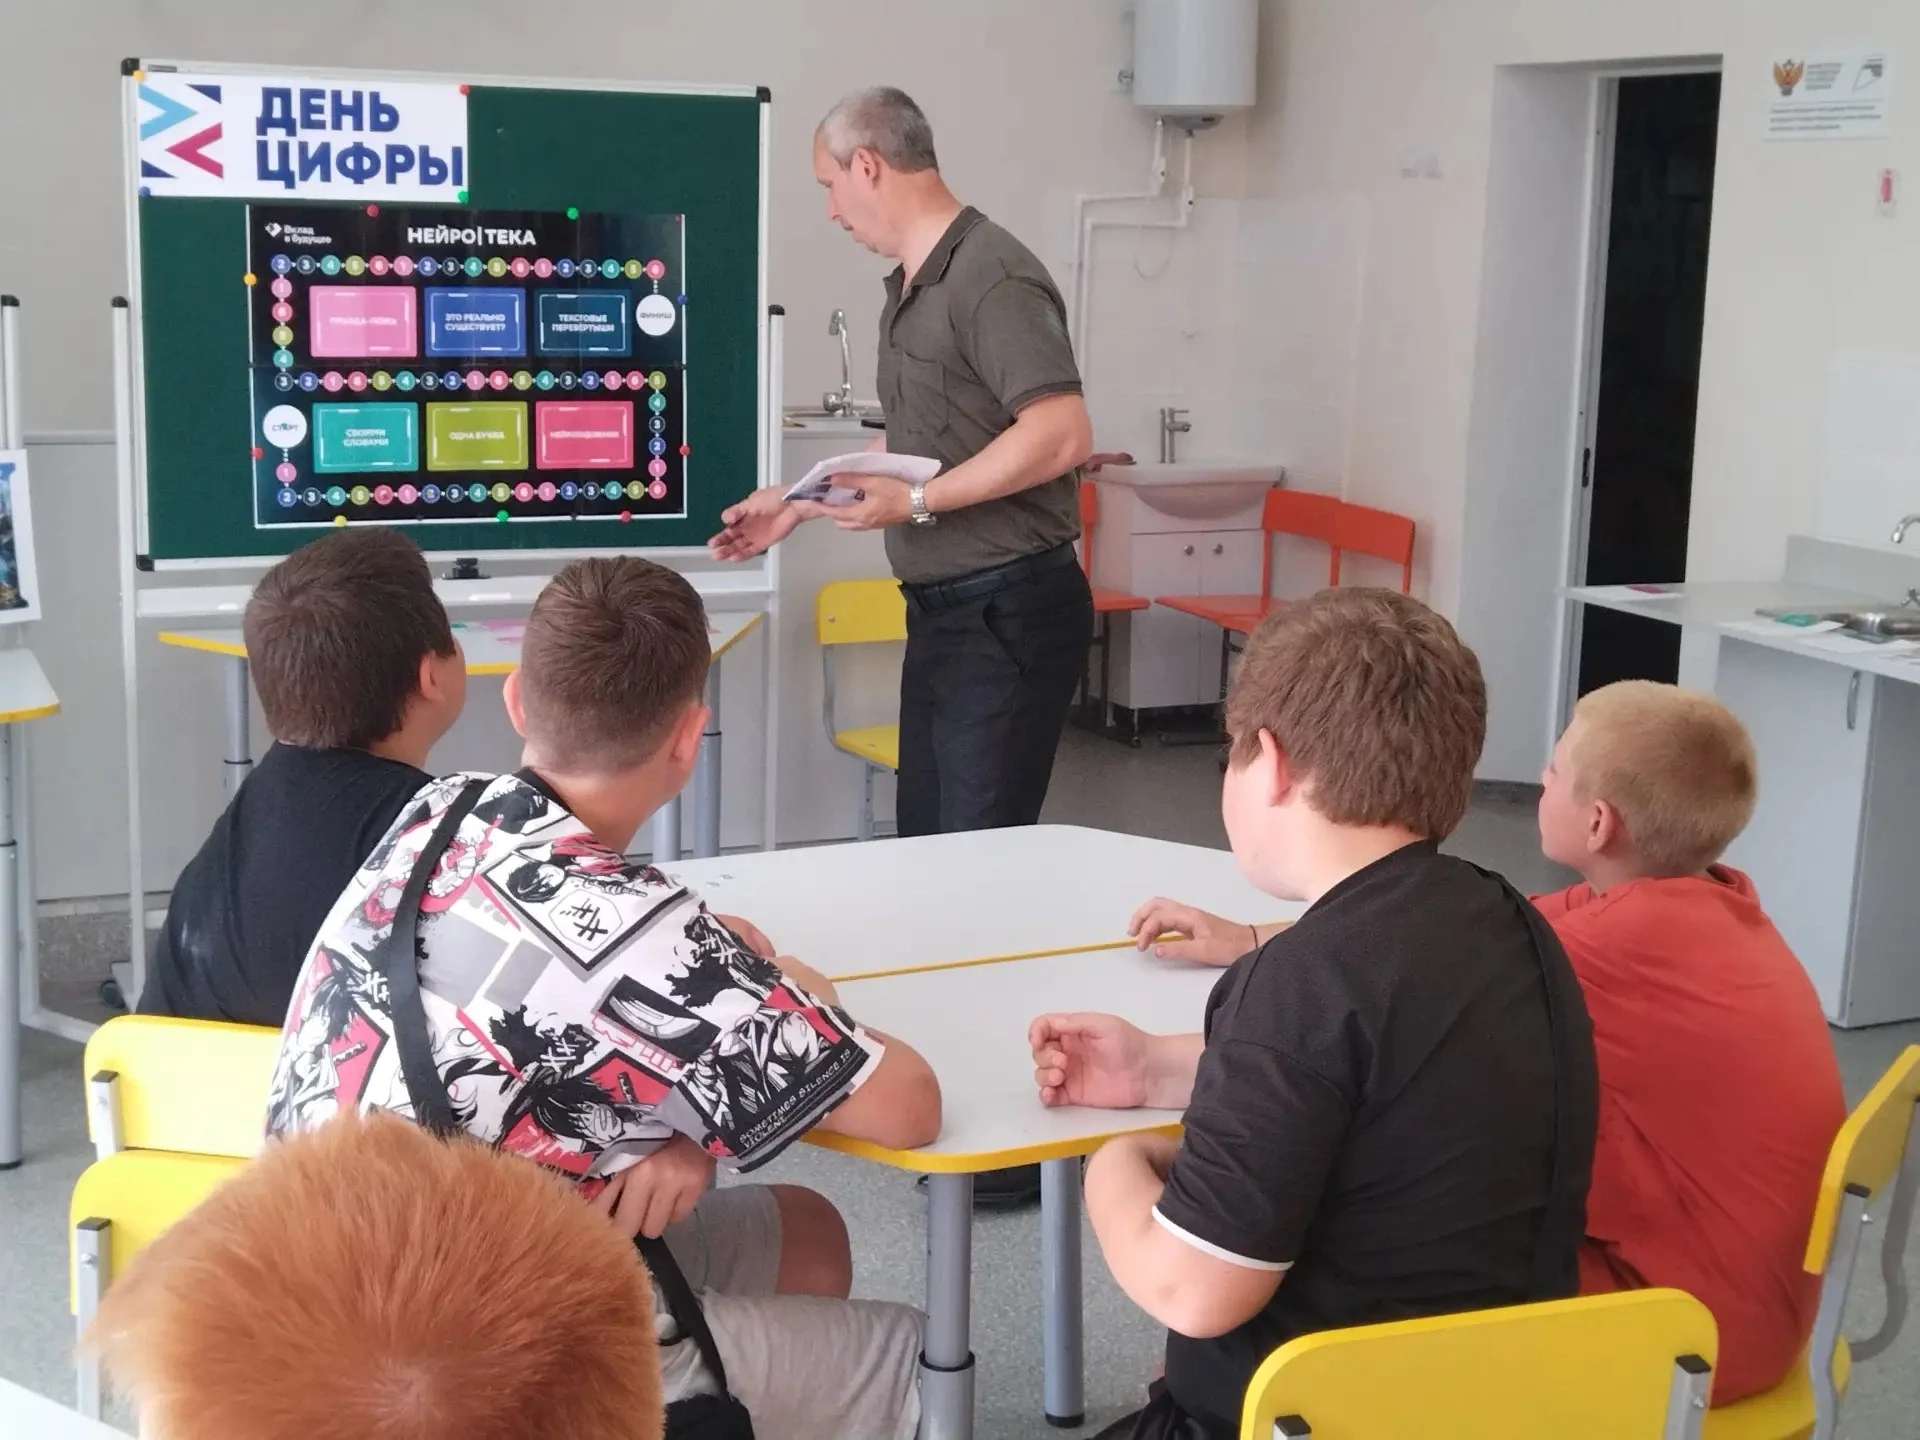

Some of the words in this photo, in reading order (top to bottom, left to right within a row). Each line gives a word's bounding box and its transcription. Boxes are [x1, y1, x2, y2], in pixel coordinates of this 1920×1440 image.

[256, 87, 400, 137] ДЕНЬ
[256, 140, 463, 189] ЦИФРЫ
[740, 1095, 797, 1144] SOMETIMES
[798, 1061, 840, 1098] SILENCE
